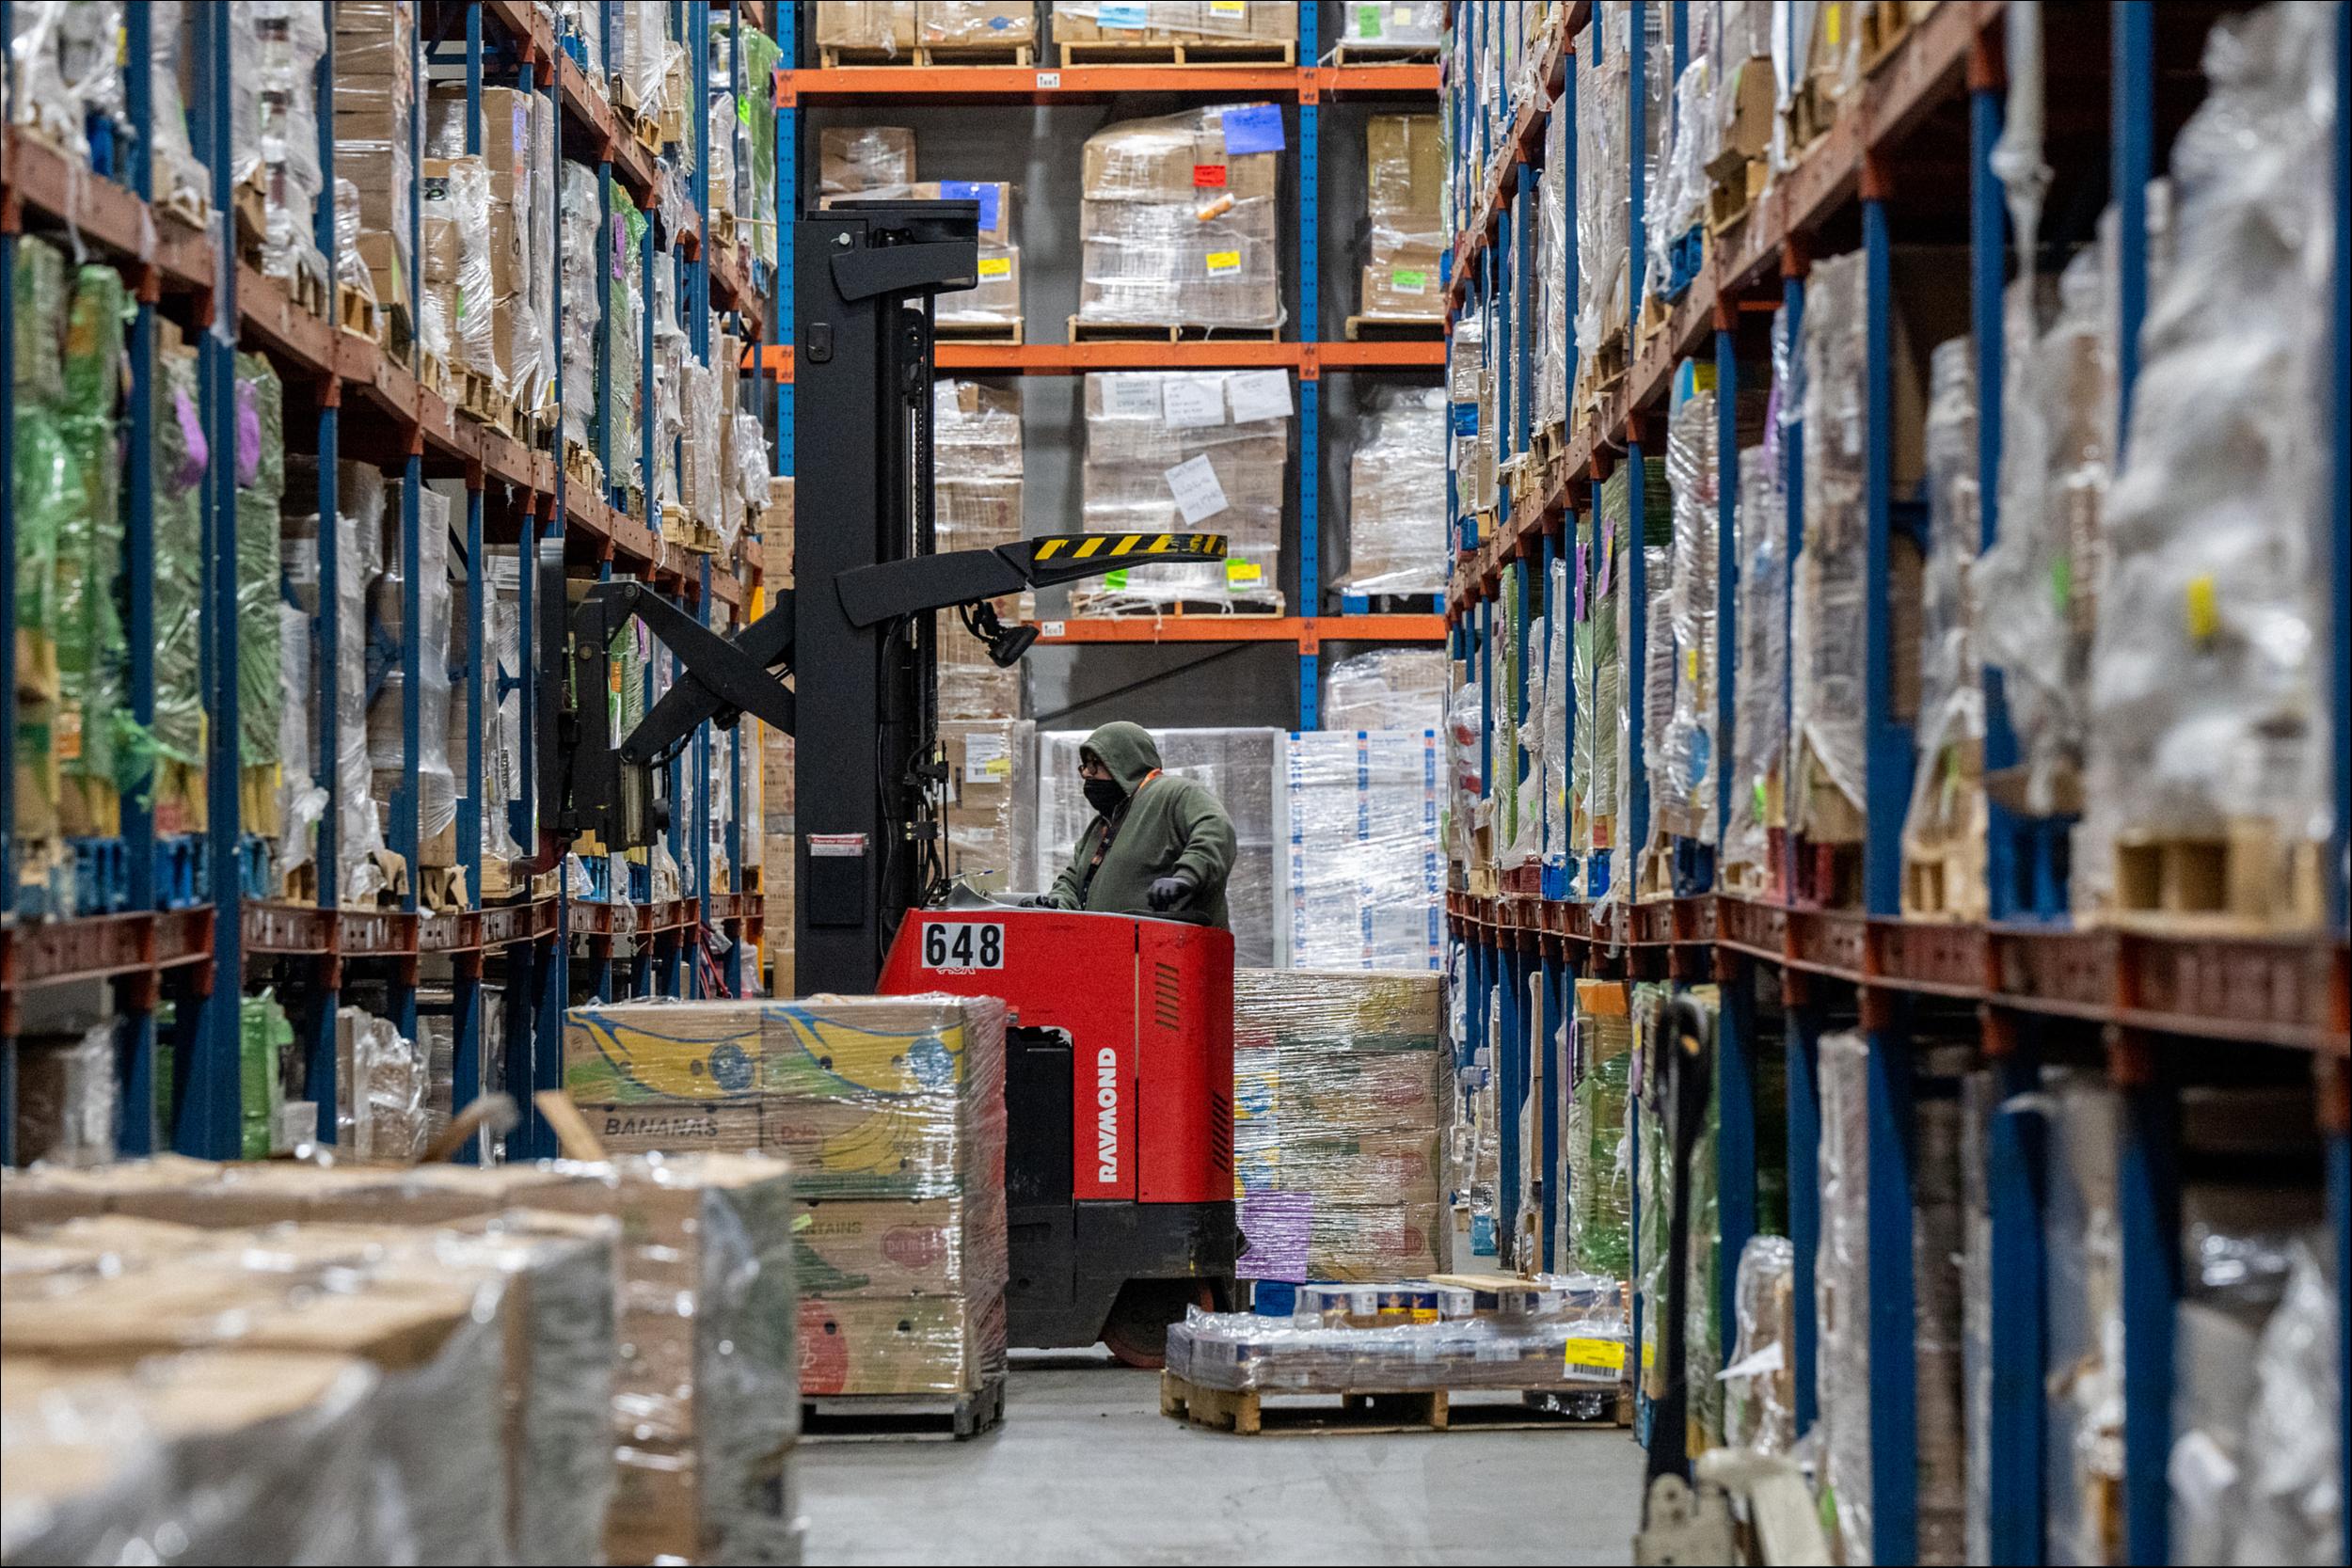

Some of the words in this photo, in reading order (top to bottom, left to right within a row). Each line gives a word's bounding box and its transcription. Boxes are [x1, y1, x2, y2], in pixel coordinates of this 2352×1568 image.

[926, 924, 1000, 967] 648
[604, 1117, 719, 1137] BANANAS
[1097, 1047, 1118, 1183] RAYMOND
